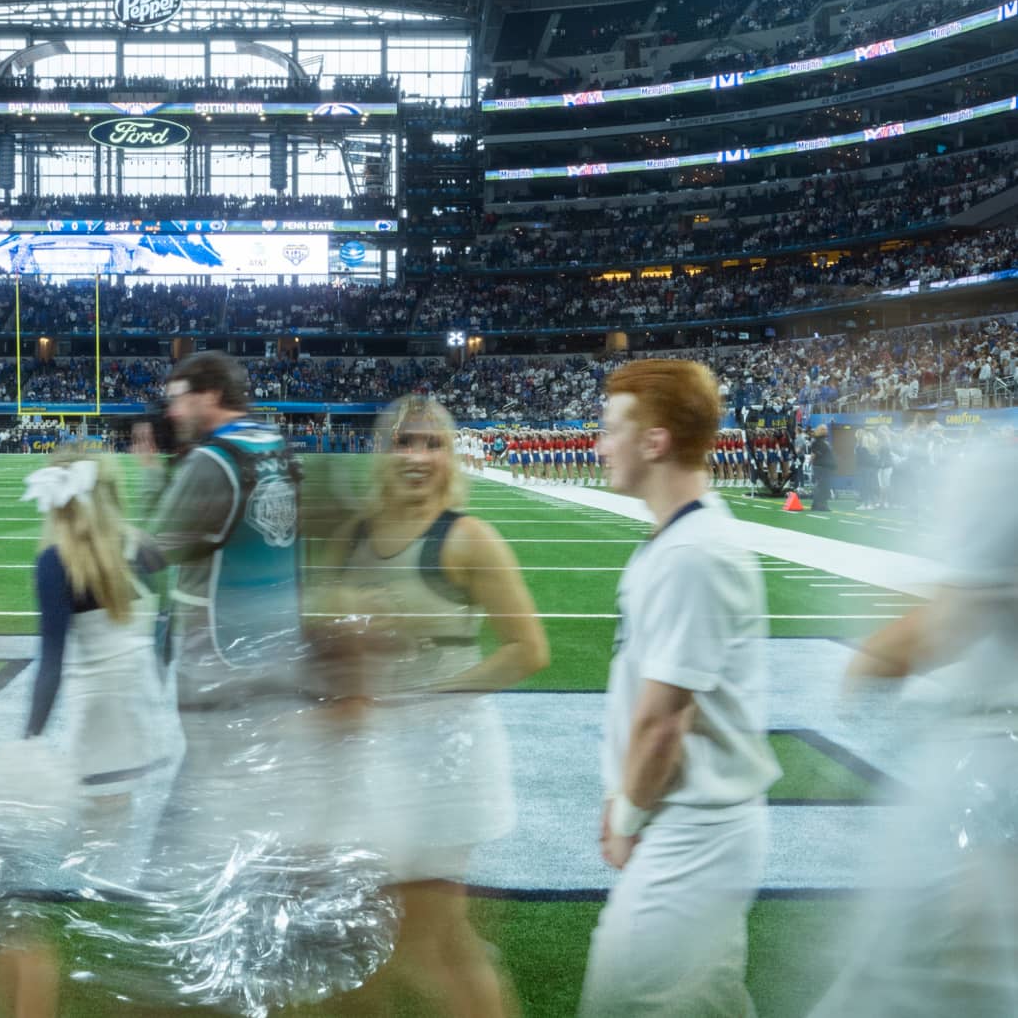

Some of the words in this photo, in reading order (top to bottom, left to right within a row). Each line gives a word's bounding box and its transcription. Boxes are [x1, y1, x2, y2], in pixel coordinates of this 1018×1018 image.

[790, 58, 822, 72] Memphis
[640, 84, 674, 96] Memphis
[31, 102, 70, 113] ANNUAL
[195, 102, 235, 113] COTTON
[236, 102, 265, 114] BOWL
[495, 97, 528, 109] Memphis
[109, 122, 169, 144] Ford
[798, 139, 831, 151] Memphis
[645, 156, 679, 168] Memphis
[499, 168, 533, 179] Memphis
[71, 222, 78, 231] 0
[195, 222, 202, 231] 0
[283, 221, 307, 230] PENN
[308, 222, 334, 231] STATE
[448, 331, 464, 345] 25
